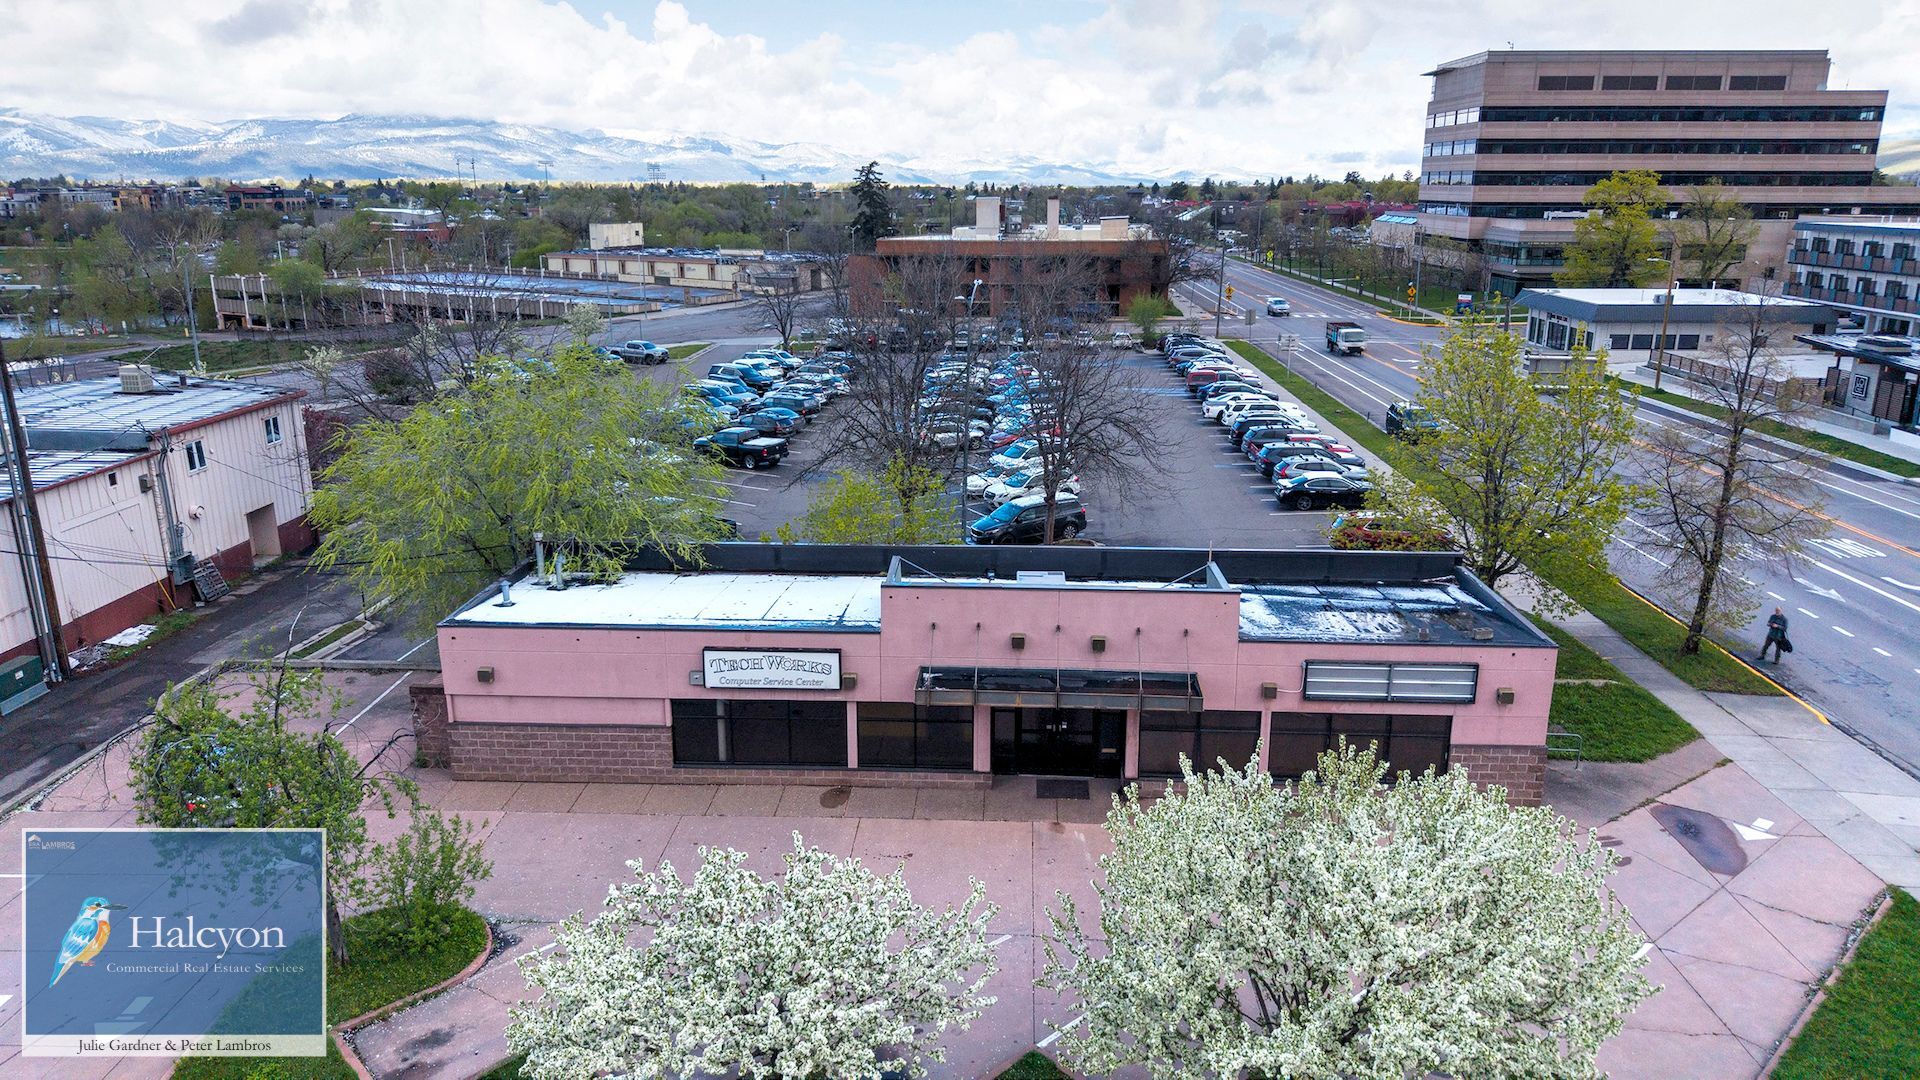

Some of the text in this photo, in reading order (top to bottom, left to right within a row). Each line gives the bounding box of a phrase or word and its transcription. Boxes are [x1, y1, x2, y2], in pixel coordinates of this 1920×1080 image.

[719, 676, 824, 686] Computer Service Center
